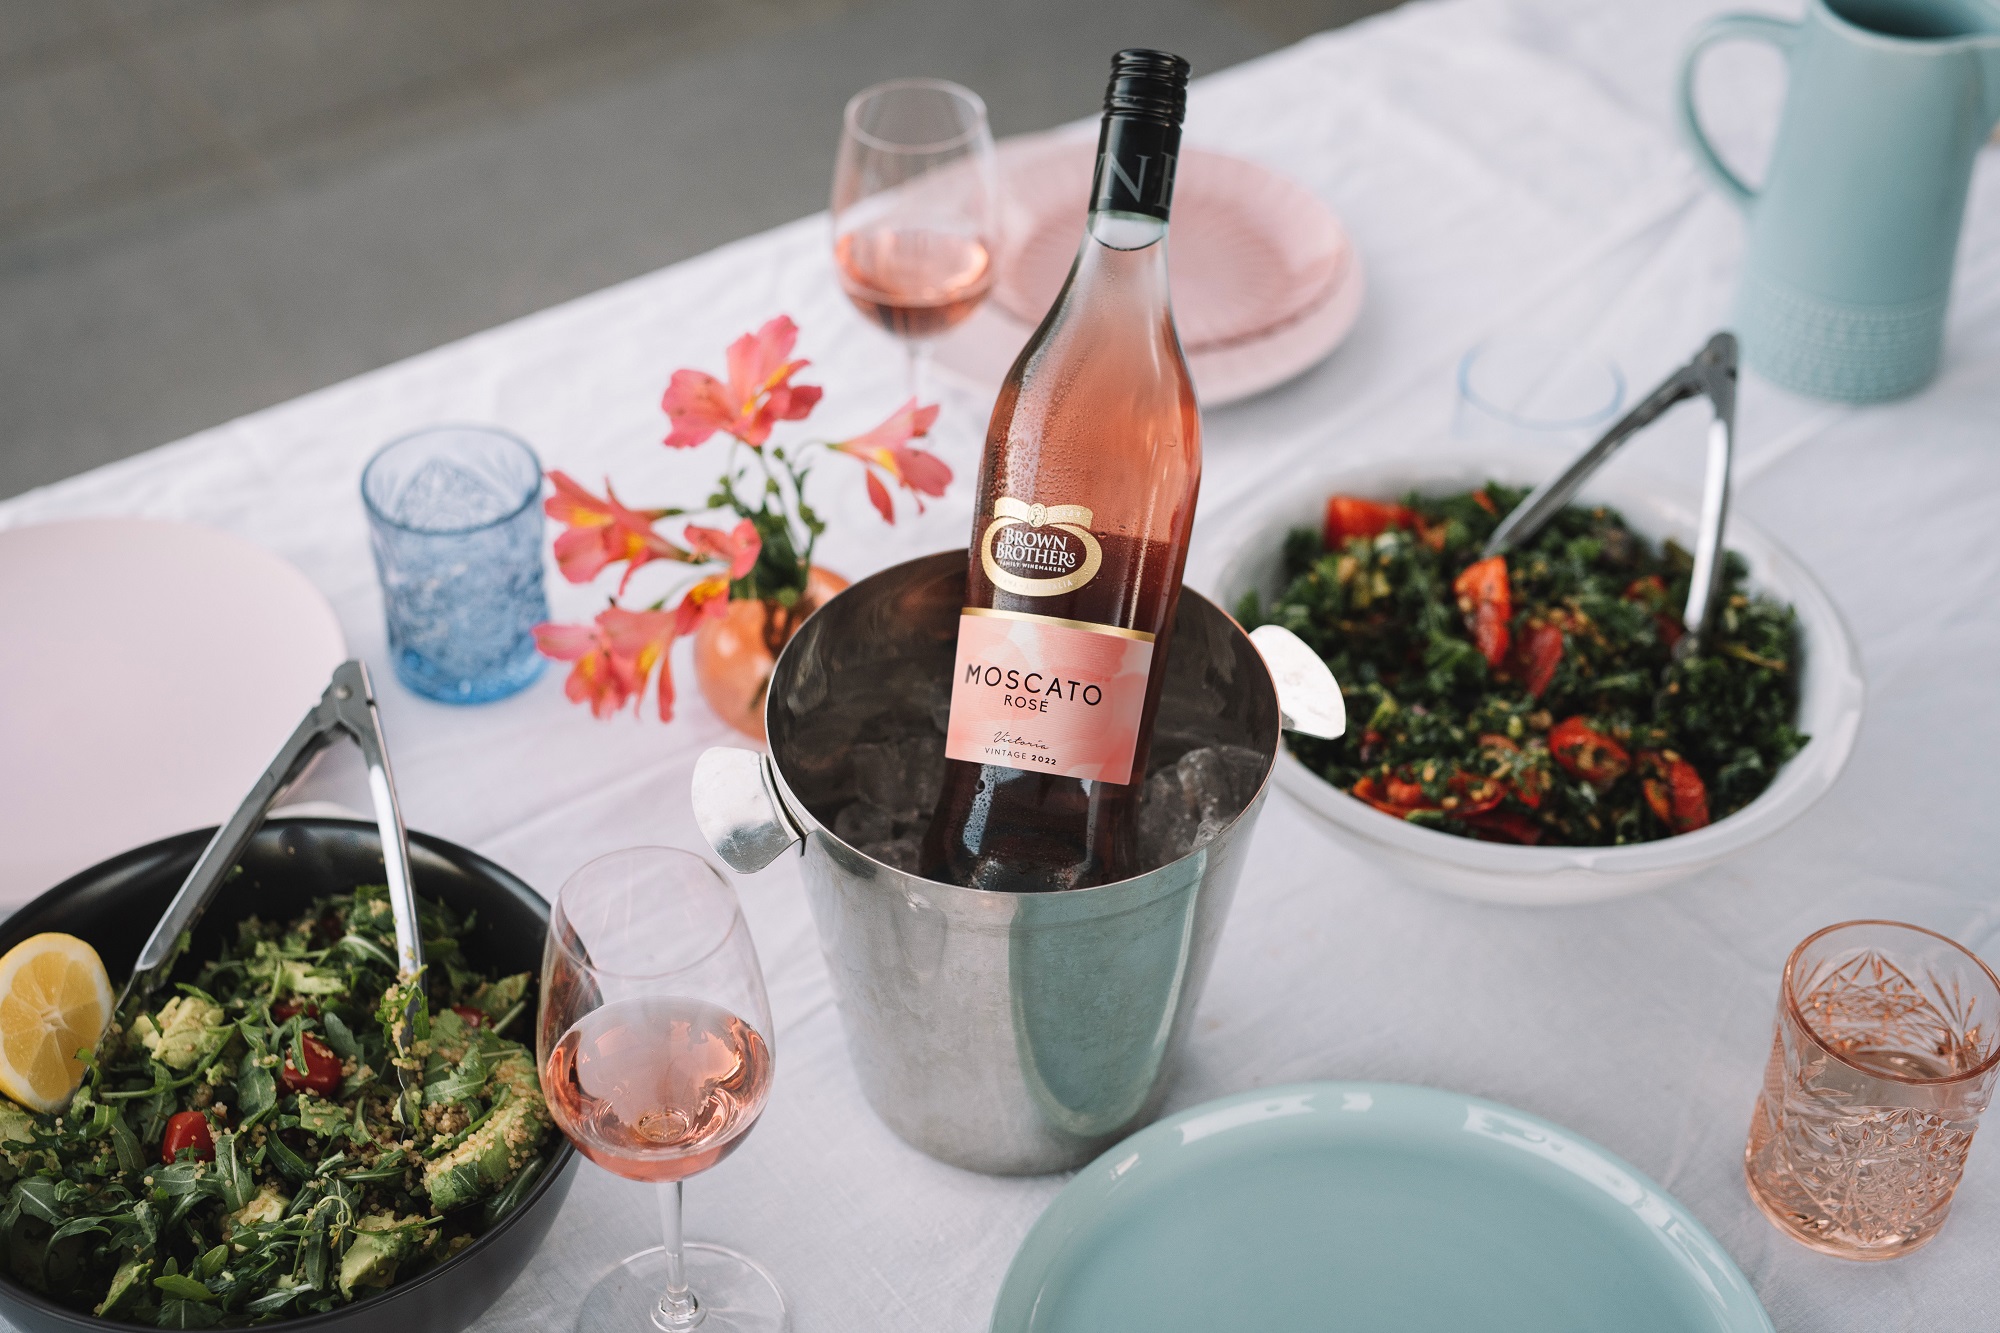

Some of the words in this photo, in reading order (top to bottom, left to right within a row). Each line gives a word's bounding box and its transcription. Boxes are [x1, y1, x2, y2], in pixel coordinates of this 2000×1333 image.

[1003, 527, 1068, 551] BROWN
[995, 541, 1076, 568] BROTHERS
[999, 560, 1020, 568] FAMILY
[1022, 561, 1066, 573] WINEMAKERS
[1025, 579, 1073, 591] AURALIA
[965, 663, 1102, 706] MOSCATO
[1004, 694, 1049, 713] ROSÉ
[993, 730, 1049, 750] Victoria
[984, 747, 1027, 760] VINTAGE
[1031, 754, 1057, 766] 2022
